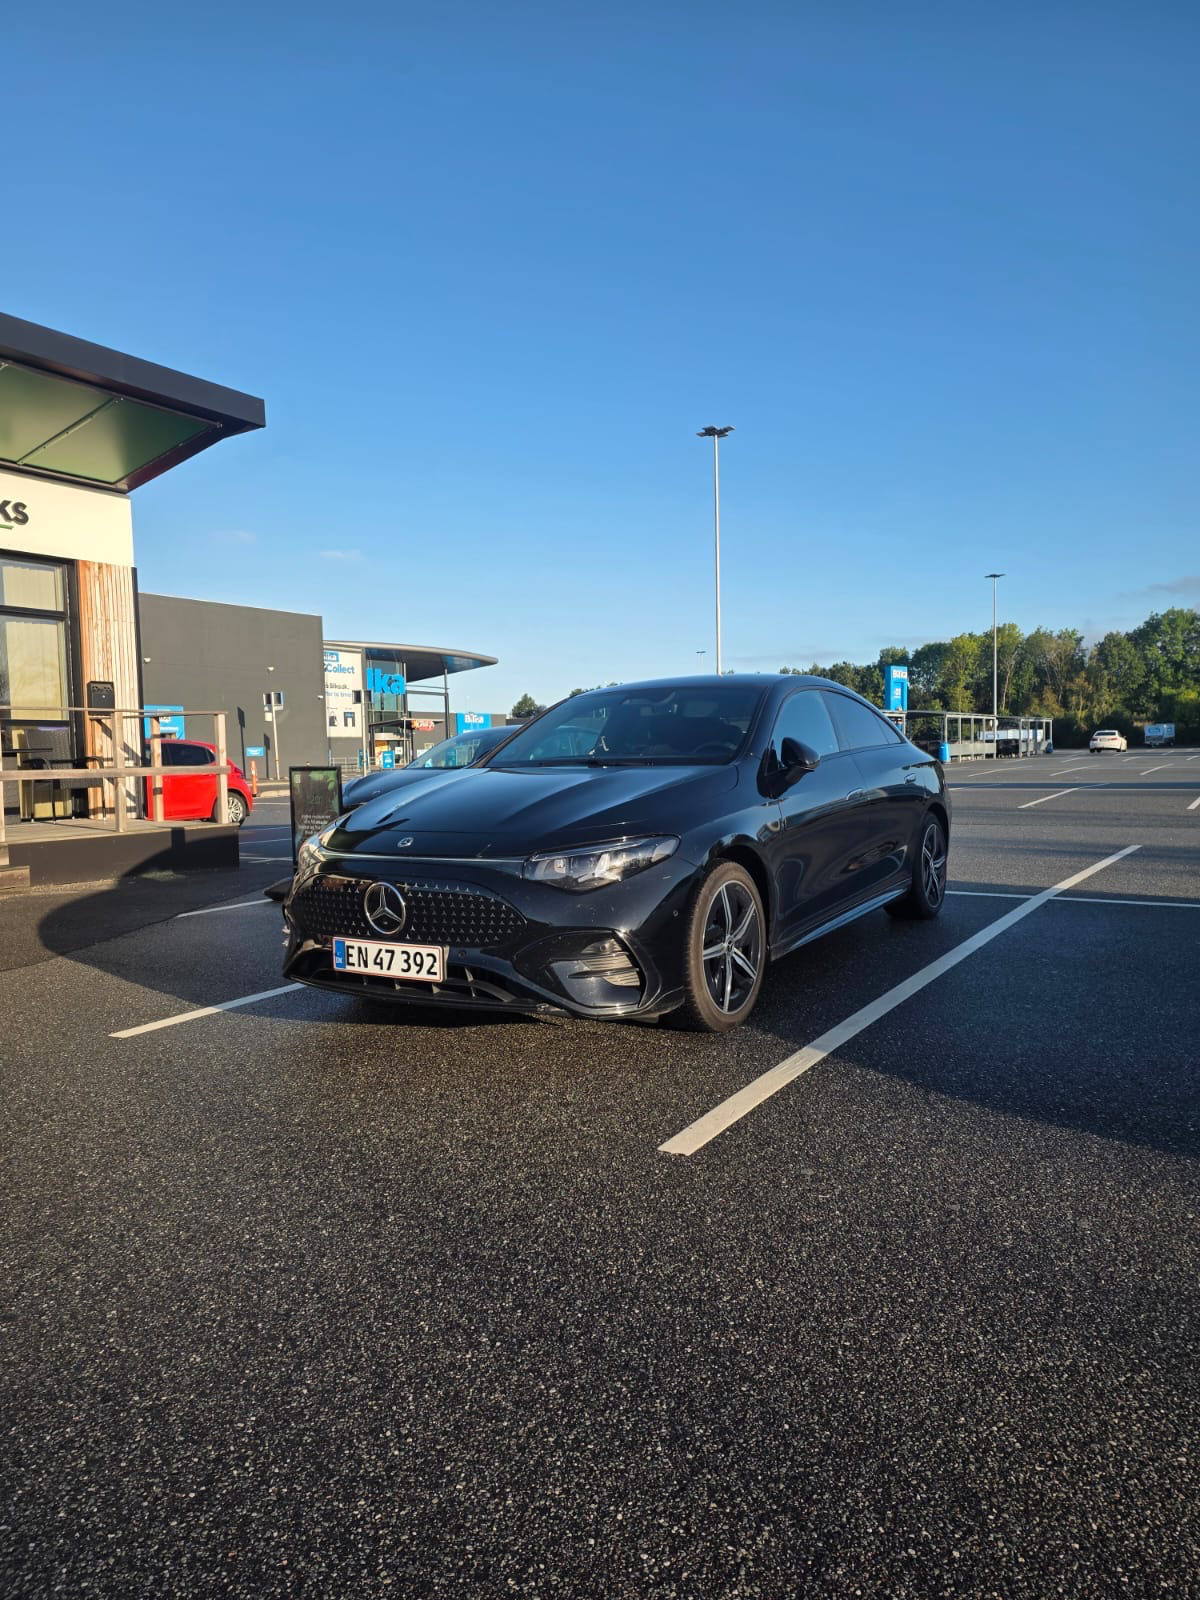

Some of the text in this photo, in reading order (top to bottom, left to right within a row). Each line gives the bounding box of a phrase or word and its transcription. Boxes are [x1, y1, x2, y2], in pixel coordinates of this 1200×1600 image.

[346, 945, 438, 976] EN 47 392
